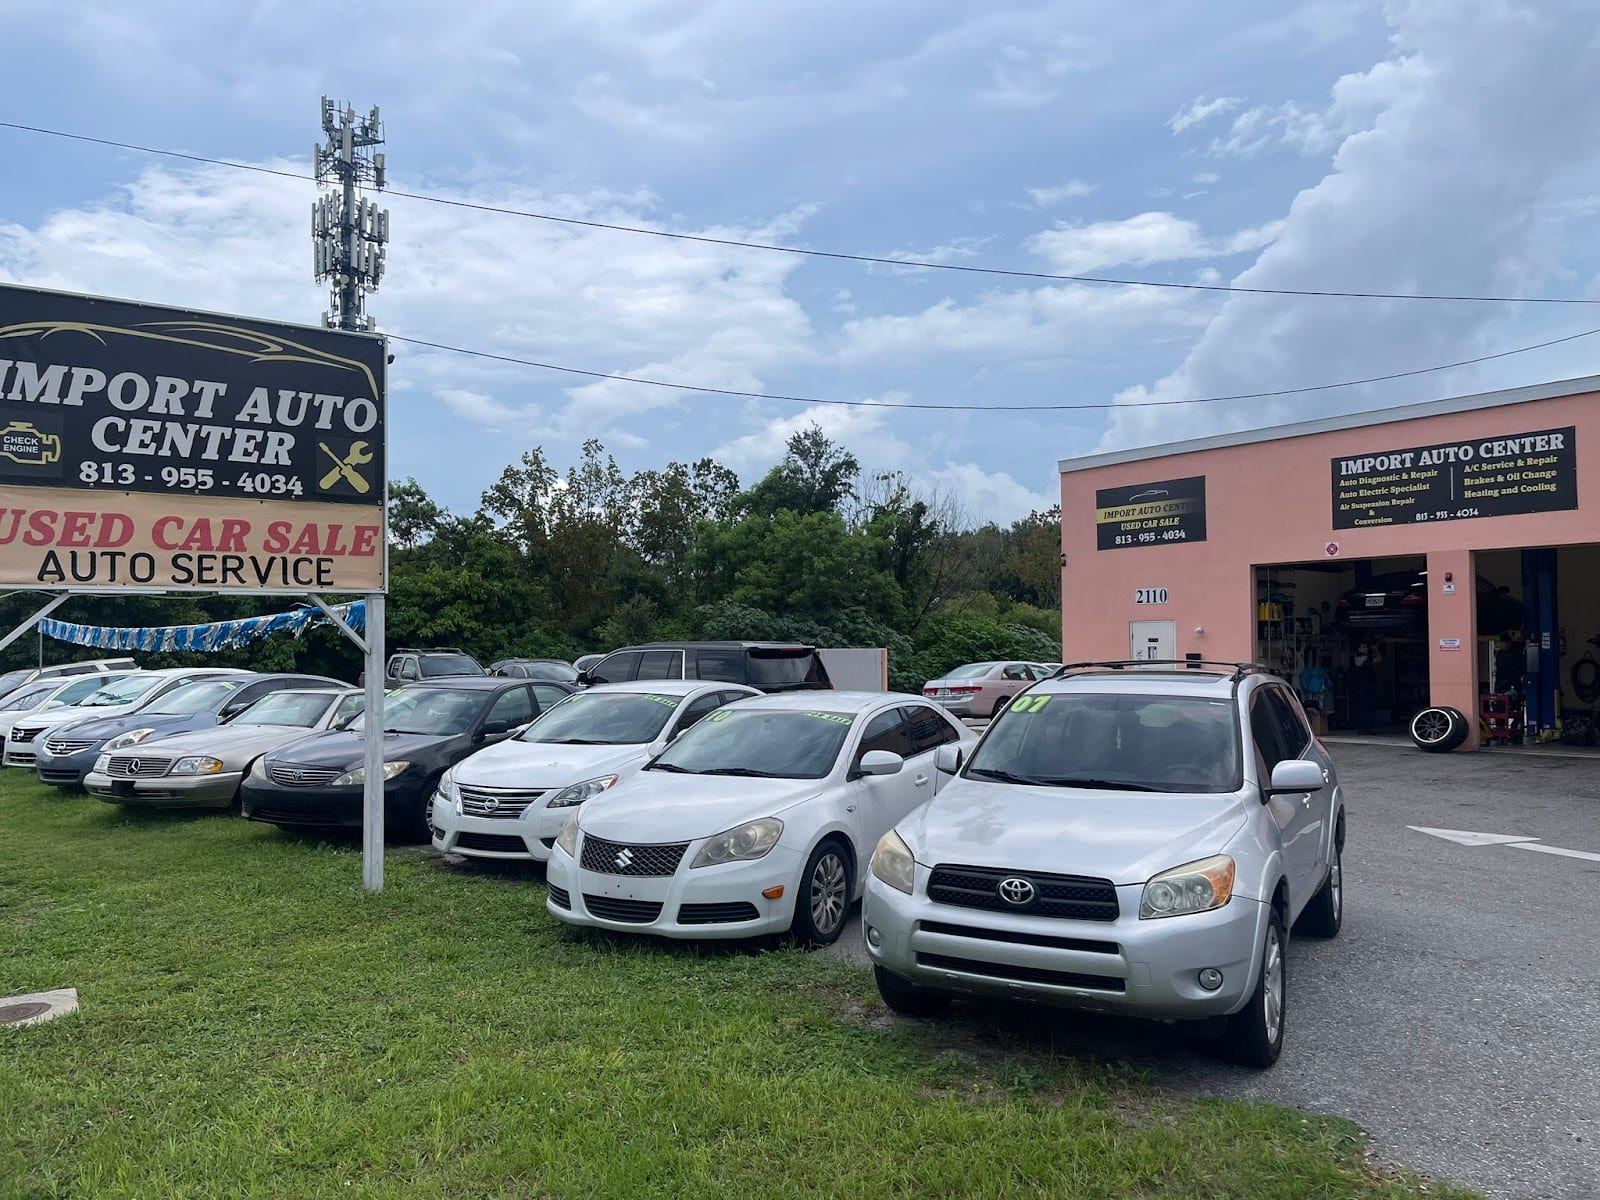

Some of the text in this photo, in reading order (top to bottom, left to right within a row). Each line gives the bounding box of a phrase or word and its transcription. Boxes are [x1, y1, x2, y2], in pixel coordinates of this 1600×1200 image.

[235, 387, 377, 432] AUTO
[3, 435, 39, 446] CHECK
[3, 444, 39, 454] ENGINE
[91, 416, 295, 465] CENTER
[1340, 433, 1564, 475] IMPORT AUTO CENTER
[1464, 455, 1559, 473] A/C Service & Repair
[79, 461, 136, 484] 813
[160, 466, 214, 490] 955
[236, 471, 303, 495] 4034
[1339, 469, 1439, 487] Auto Diagnostic & Repair
[1464, 469, 1557, 486] Brakes & Oil Change
[1339, 483, 1430, 499] Auto Electric Specialist
[1464, 482, 1557, 498] Heating and Cooling
[1103, 502, 1192, 520] IMPORT AUTO CENT
[1351, 499, 1390, 510] Suspension
[1391, 497, 1416, 506] Repair
[1354, 517, 1393, 525] Conversion
[1415, 512, 1428, 521] 813
[1456, 508, 1479, 517] 4034
[0, 508, 380, 557] USED CAR SALE
[1120, 517, 1180, 531] USED CAR SALE
[1115, 535, 1132, 544] 813
[1138, 532, 1156, 542] 955
[1162, 529, 1186, 540] 4034
[37, 549, 334, 586] AUTO SERVICE
[1136, 588, 1167, 604] 2110
[1011, 695, 1052, 713] 07
